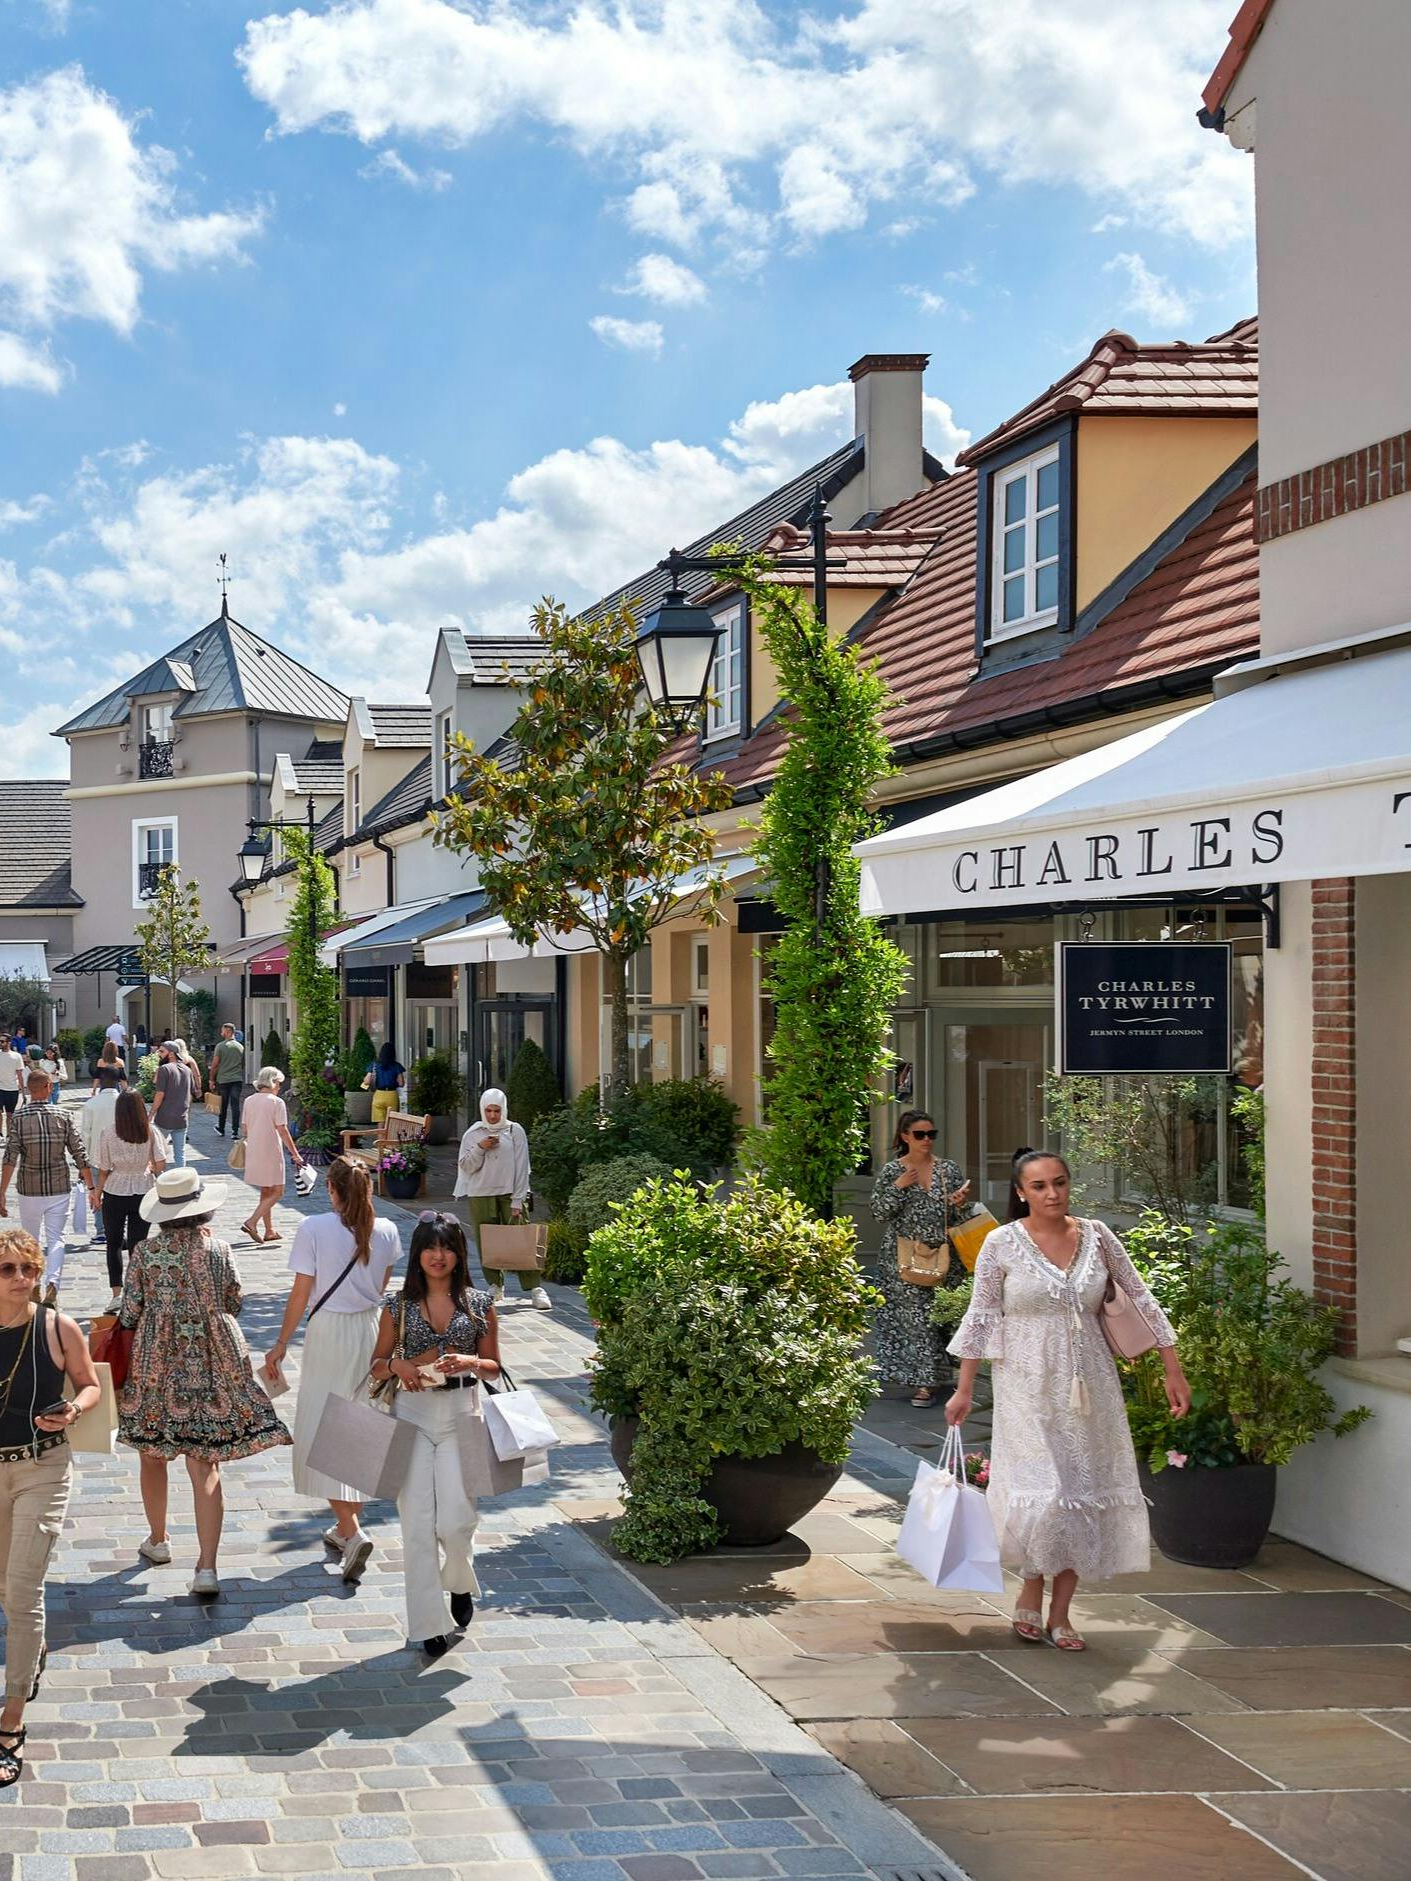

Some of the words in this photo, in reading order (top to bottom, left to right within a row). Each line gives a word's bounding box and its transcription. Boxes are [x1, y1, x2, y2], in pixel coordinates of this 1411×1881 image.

[952, 809, 1283, 893] CHARLES
[1098, 981, 1196, 992] CHARLES
[1078, 996, 1215, 1010] TYRWHITT
